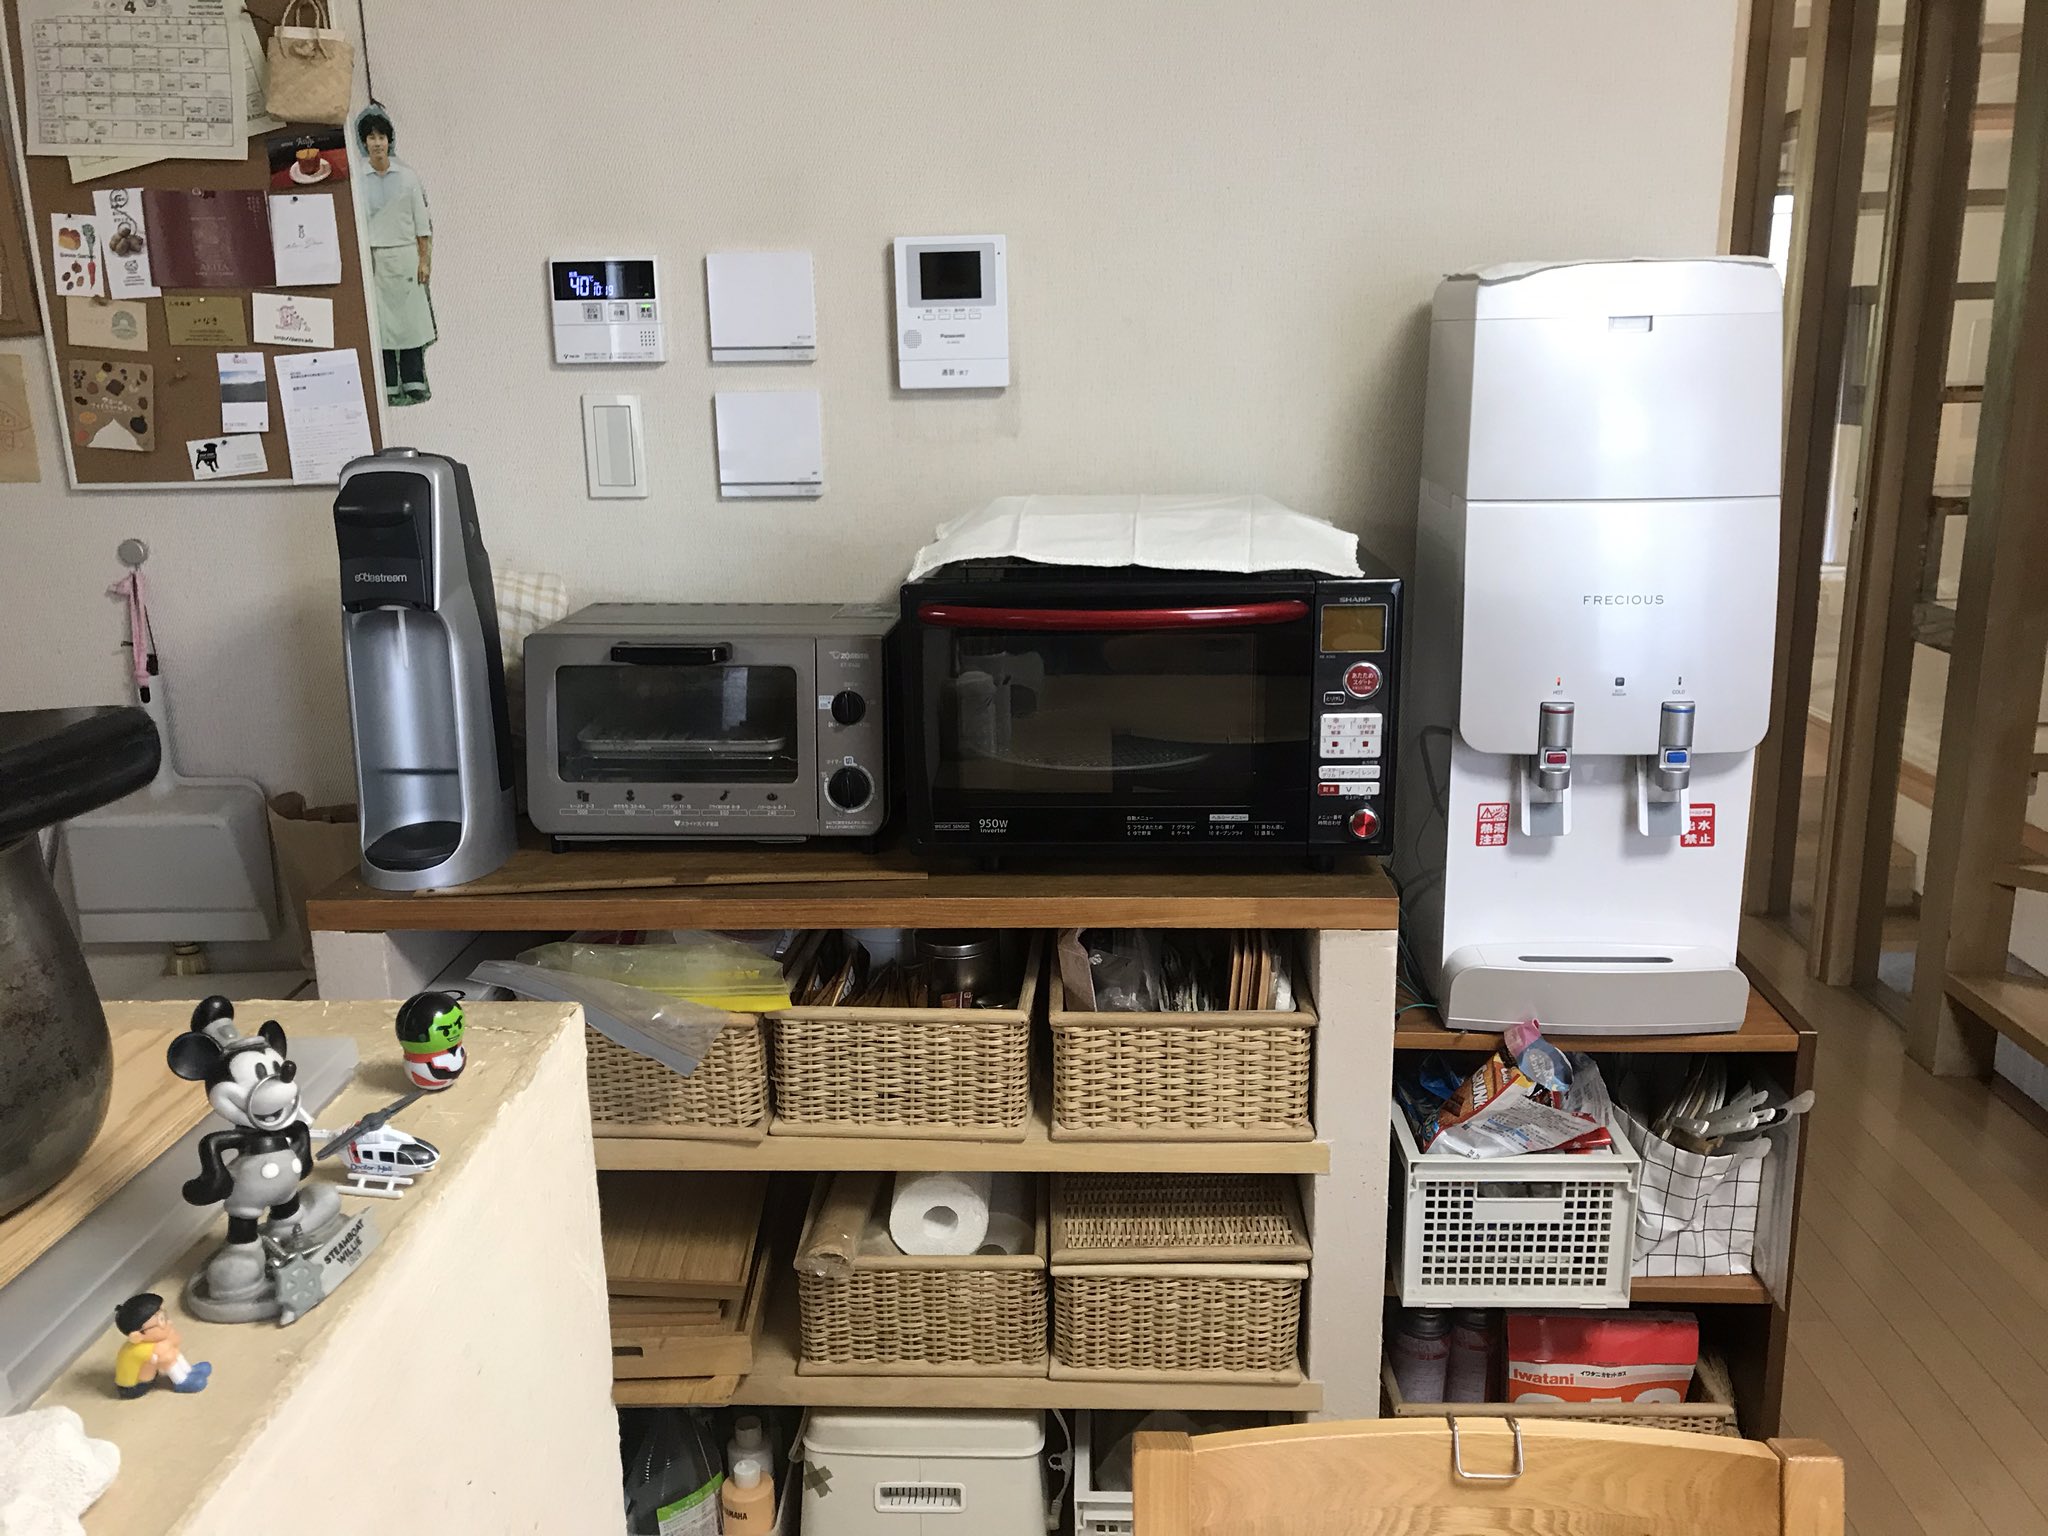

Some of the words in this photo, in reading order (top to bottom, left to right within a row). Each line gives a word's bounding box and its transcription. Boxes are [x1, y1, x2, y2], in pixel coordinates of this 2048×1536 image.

[124, 0, 137, 14] 4
[569, 275, 590, 297] 40
[354, 572, 408, 583] sodastream
[1583, 595, 1665, 605] FRECIOUS
[978, 818, 1009, 828] 950W
[1480, 822, 1506, 834] 熱湯
[1479, 833, 1505, 845] 注意
[1684, 833, 1712, 845] 禁止
[323, 1218, 364, 1265] STEAMBOAT
[337, 1236, 363, 1264] WILLIE
[1513, 1368, 1575, 1386] Iwatani
